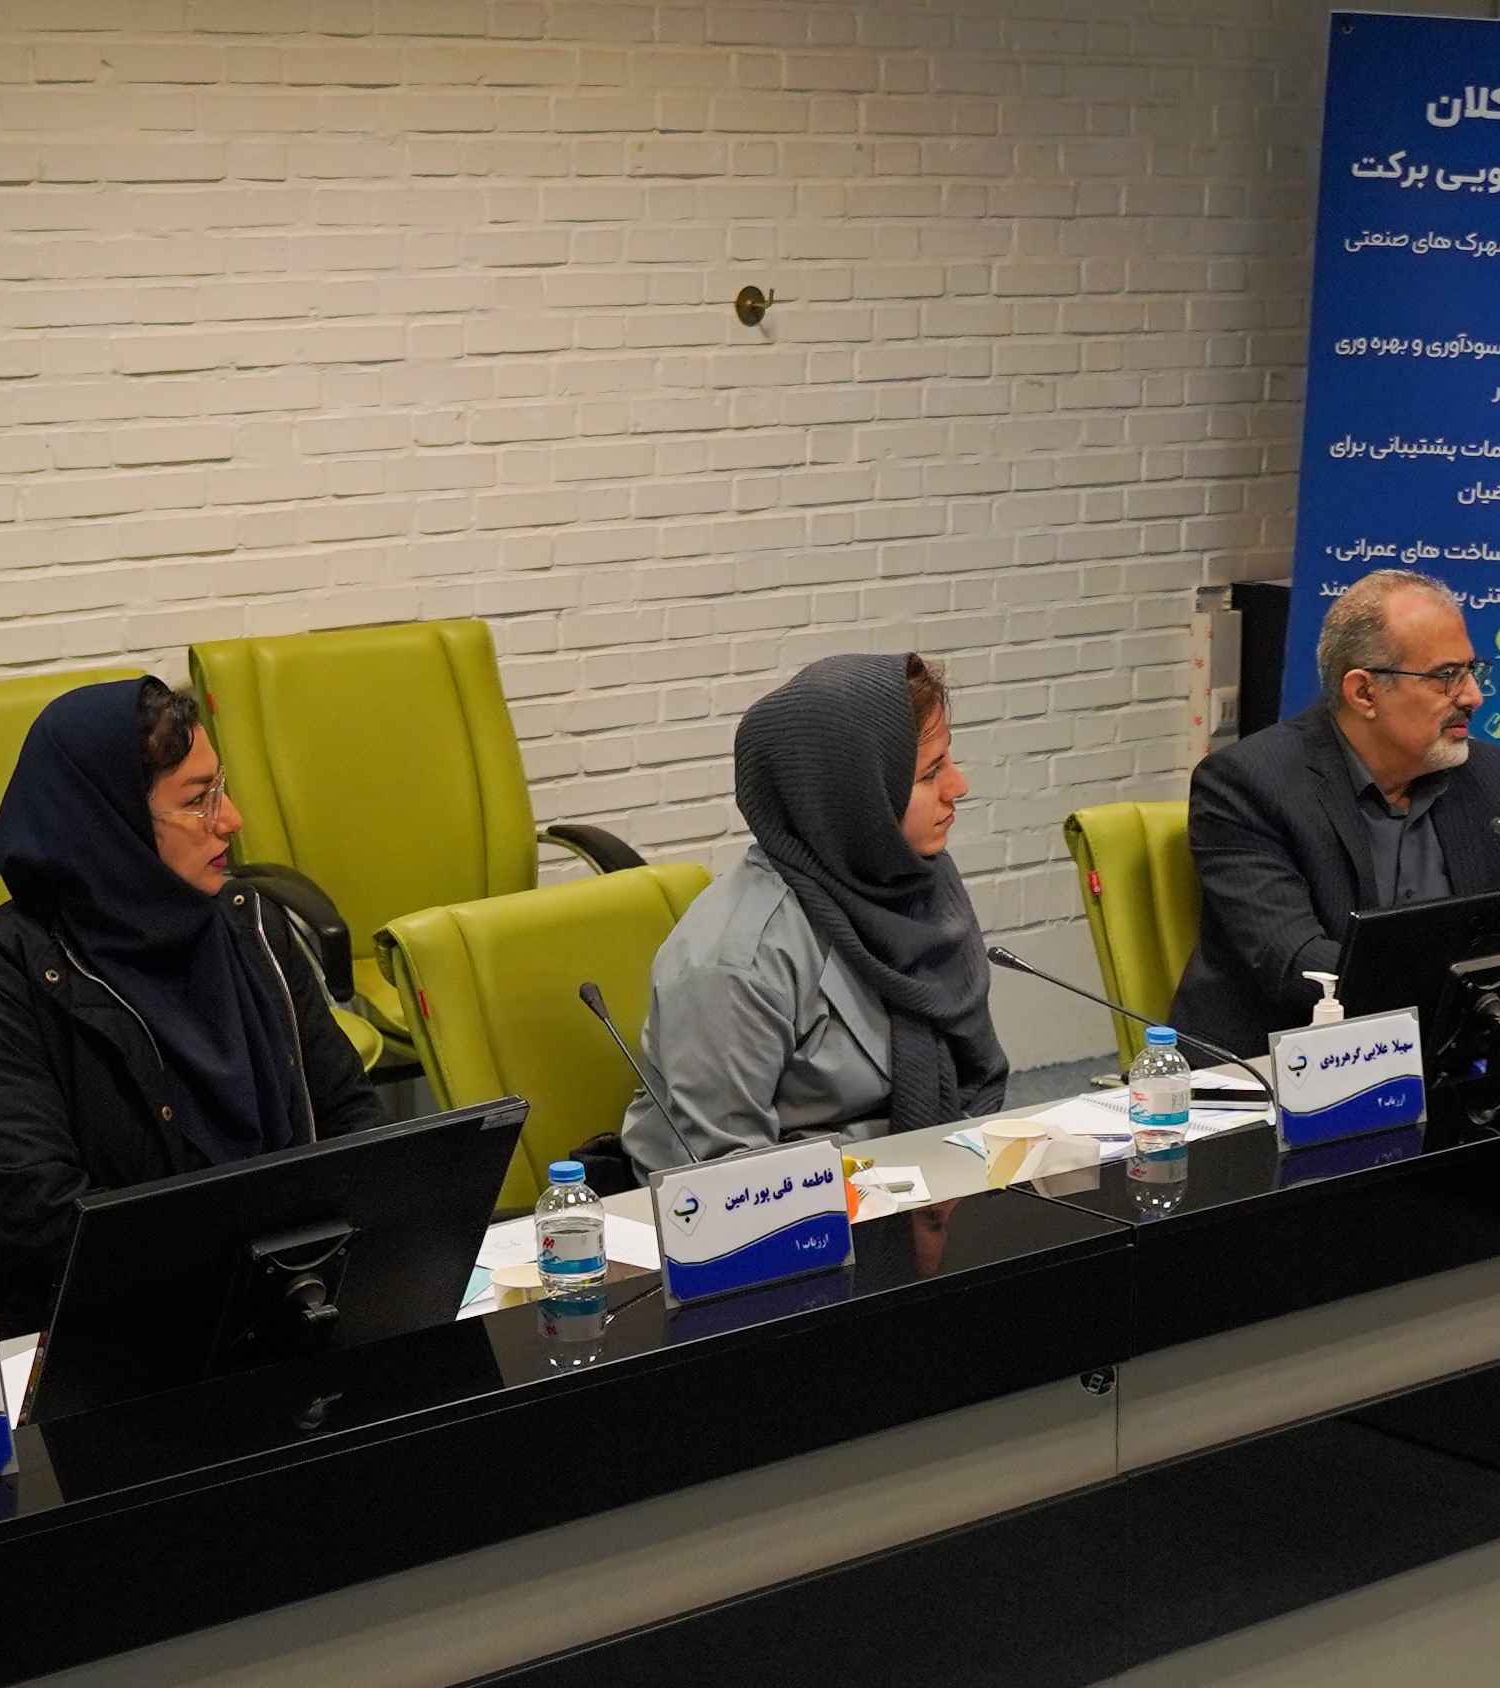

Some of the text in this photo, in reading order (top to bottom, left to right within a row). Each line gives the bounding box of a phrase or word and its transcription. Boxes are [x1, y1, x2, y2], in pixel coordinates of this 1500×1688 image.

[1352, 151, 1428, 188] برکت
[1346, 232, 1409, 252] صنعتی
[1412, 232, 1451, 253] های
[1336, 338, 1367, 355] وری
[1370, 338, 1408, 355] بهره
[1412, 339, 1422, 356] و
[1330, 436, 1366, 457] برای
[1370, 437, 1457, 461] پشتیبانی
[1336, 539, 1396, 561] عمرانی
[1401, 541, 1440, 563] های
[1392, 1040, 1413, 1052] سهیلا
[725, 1170, 833, 1210] فاطمه قلی پور امین
[803, 1234, 828, 1248] ارزیاب
